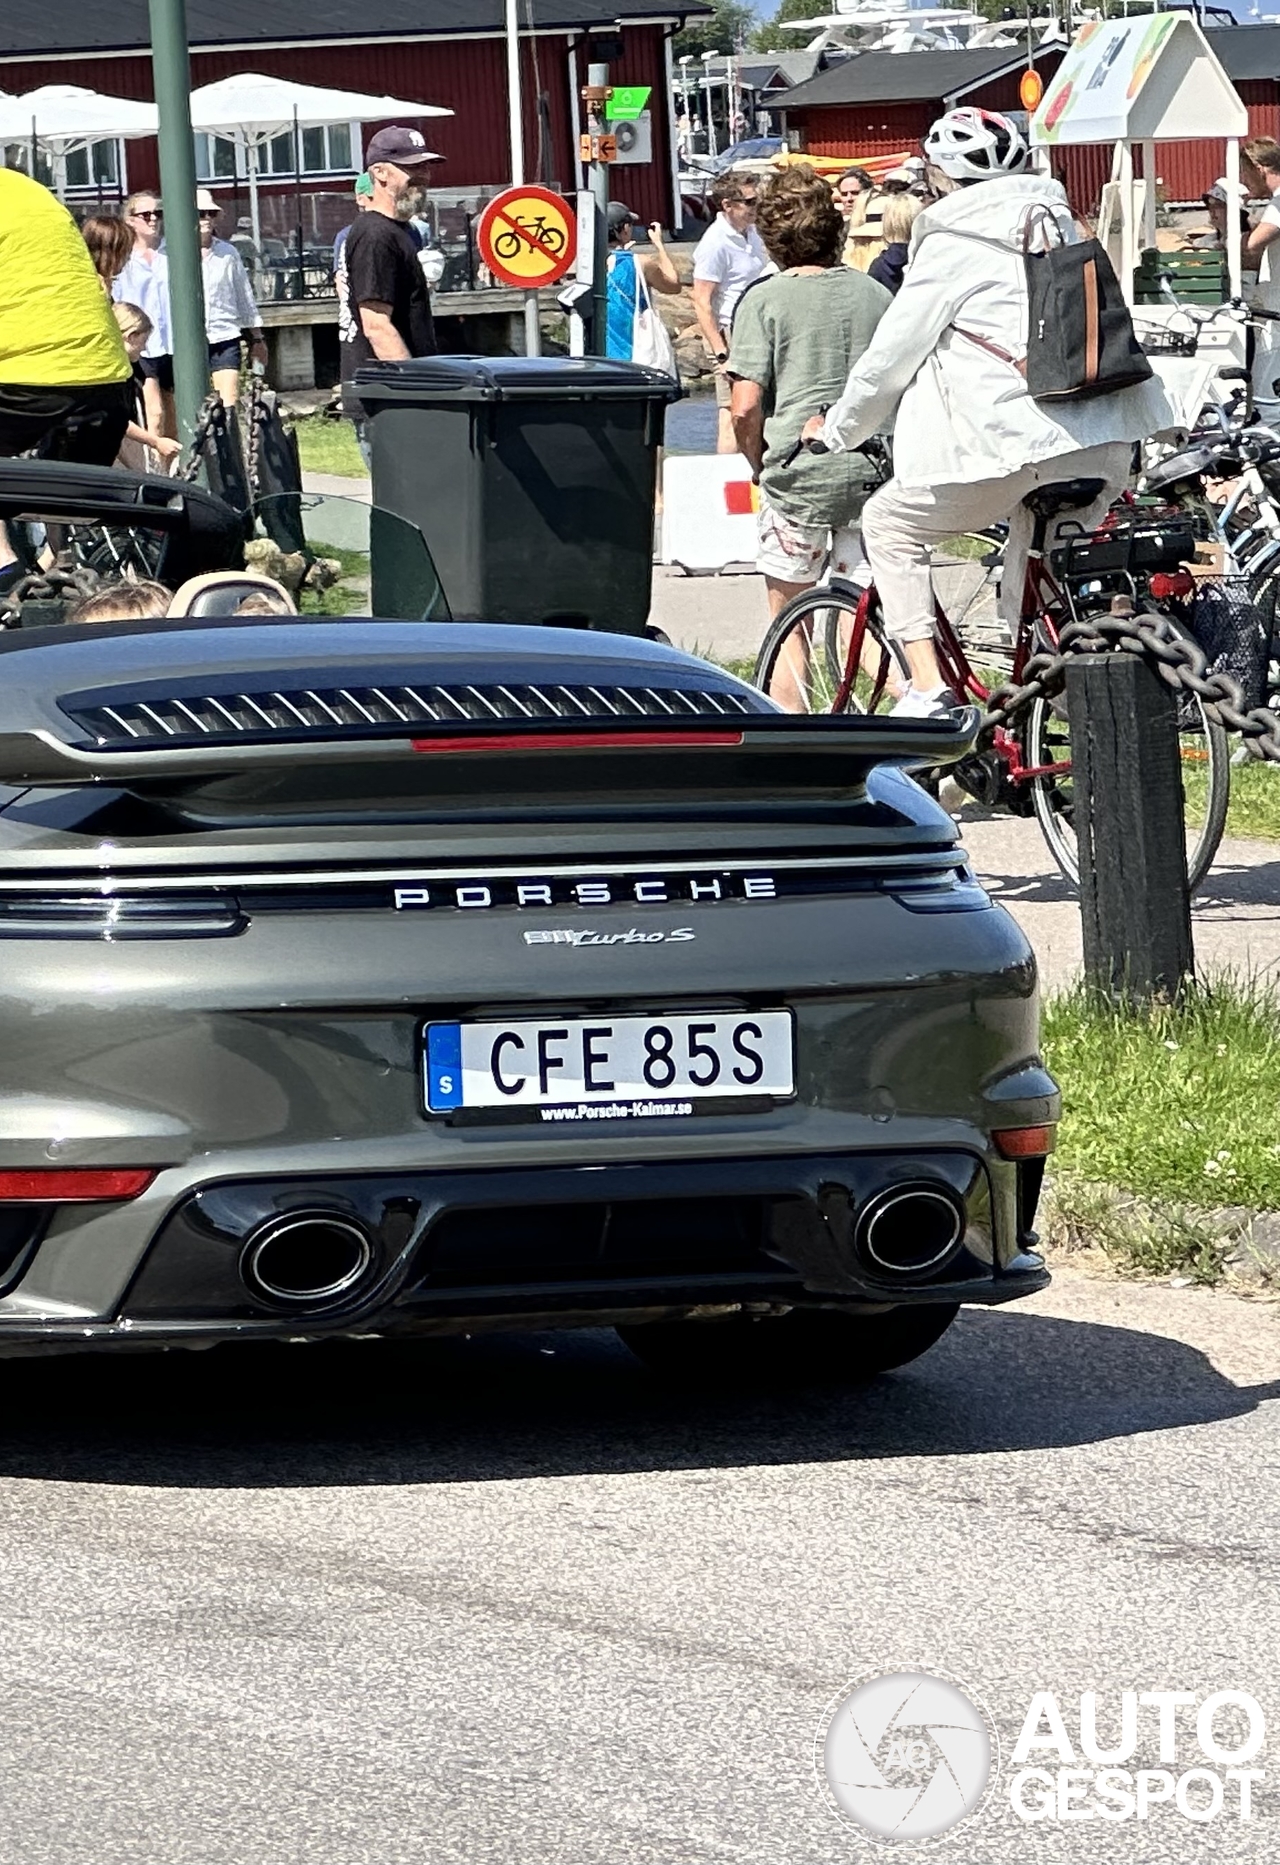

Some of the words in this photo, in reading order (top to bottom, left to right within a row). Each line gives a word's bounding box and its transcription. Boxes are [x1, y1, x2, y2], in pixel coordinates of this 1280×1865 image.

[394, 877, 777, 910] PORSCHE
[665, 928, 696, 943] S
[490, 1027, 615, 1095] CFE
[643, 1022, 764, 1089] 85S
[439, 1076, 453, 1094] S
[541, 1102, 693, 1120] www.Porsche-Kalmar.se
